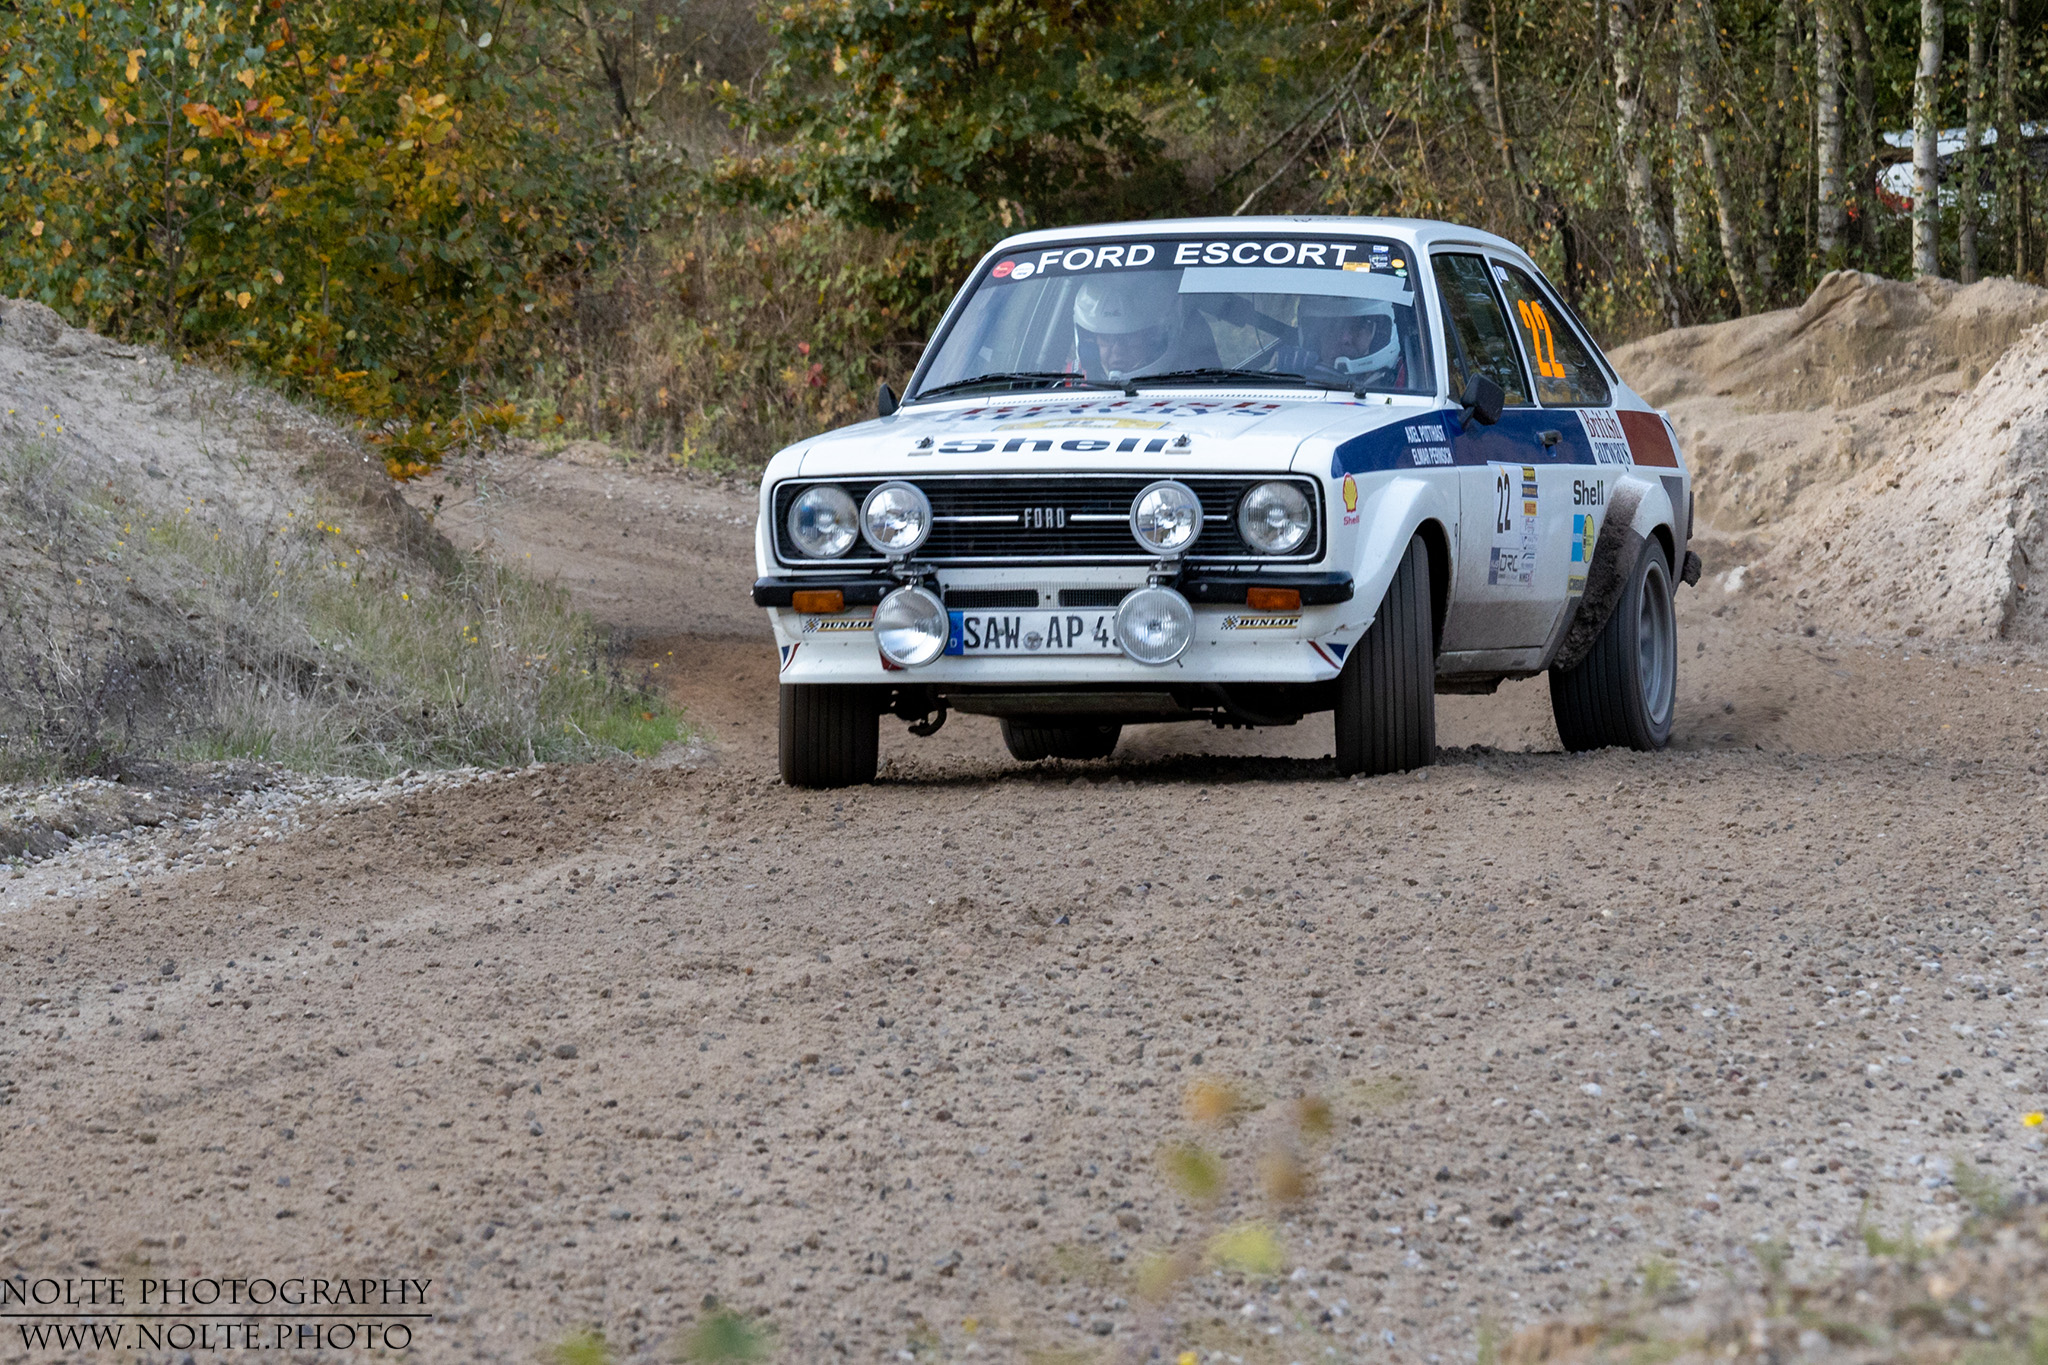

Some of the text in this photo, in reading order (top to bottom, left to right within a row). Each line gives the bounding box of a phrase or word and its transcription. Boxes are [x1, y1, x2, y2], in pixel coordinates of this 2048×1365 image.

[1035, 244, 1156, 275] FORD
[1173, 242, 1357, 267] ESCORT
[1517, 299, 1566, 378] 22
[1579, 409, 1622, 439] British
[938, 438, 1167, 453] Shell
[1497, 473, 1511, 534] 22
[1573, 480, 1604, 505] Shell
[1024, 507, 1065, 528] FORD
[1343, 515, 1360, 526] Shell
[963, 615, 1119, 649] SAW AP 4
[1239, 618, 1299, 626] DUNLOP
